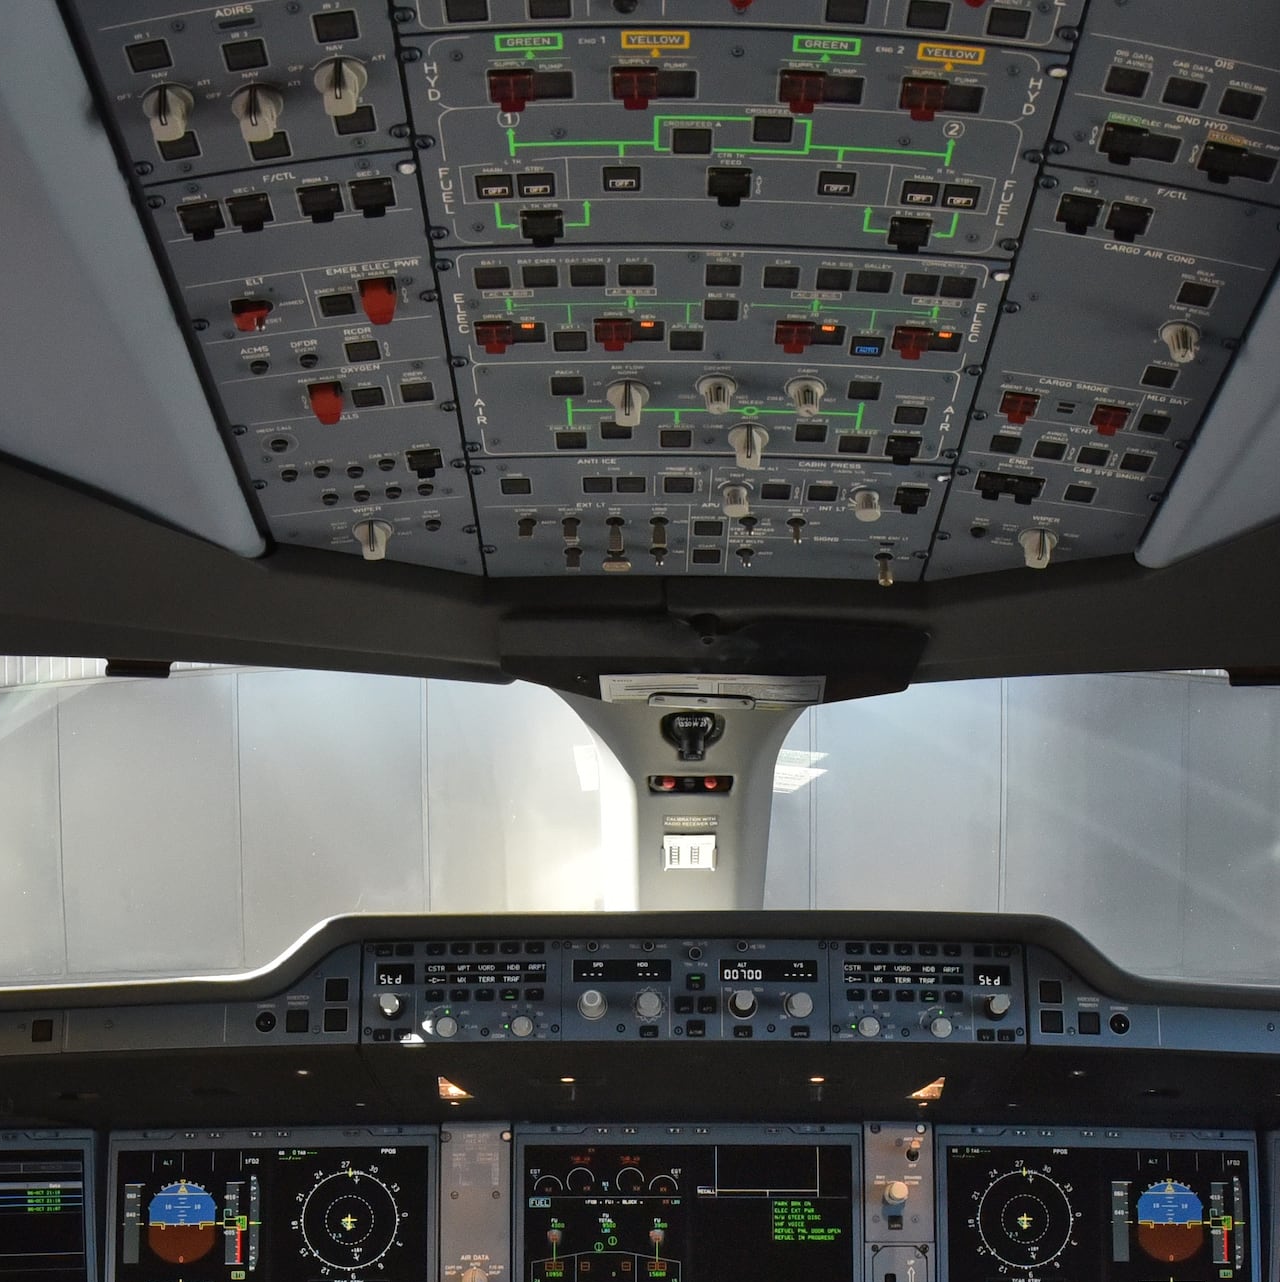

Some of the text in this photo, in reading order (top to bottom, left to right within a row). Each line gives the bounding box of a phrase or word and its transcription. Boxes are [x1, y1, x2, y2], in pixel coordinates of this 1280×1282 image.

[215, 4, 254, 19] ADIRS
[505, 36, 552, 47] GREEN
[600, 35, 607, 45] 1
[628, 34, 681, 46] YELLOW
[803, 39, 849, 51] GREEN
[325, 44, 344, 52] NAV
[896, 44, 905, 55] 2
[925, 47, 979, 60] YELLOW
[1214, 58, 1236, 71] OIS
[1175, 114, 1229, 132] GND HYD
[261, 171, 297, 184] F/CTL
[437, 167, 456, 216] FUEL
[1156, 187, 1189, 200] F/CTL
[994, 179, 1017, 227] FUEL
[1103, 242, 1196, 265] CARGO AIR COND
[325, 259, 419, 276] EMER ELEC PWR
[245, 276, 265, 288] ELT
[343, 326, 372, 337] RCDR
[289, 338, 318, 349] DFDR
[239, 344, 270, 356] ACMS
[339, 363, 381, 375] OXYGEN
[1038, 377, 1110, 394] CARGO SMOKE
[1146, 393, 1189, 408] MLG BAY
[1069, 426, 1094, 436] VENT
[798, 461, 862, 470] CABIN PRESS
[1008, 457, 1029, 467] ENG
[1073, 465, 1146, 482] CAB SYS SMOKE
[352, 505, 382, 514] WIPER
[1031, 514, 1062, 525] WIPER
[812, 535, 839, 543] SIGNS
[427, 964, 446, 973] CSTR
[457, 963, 471, 972] WPT
[506, 963, 521, 972] NDB
[528, 963, 546, 971] ARPT
[843, 964, 862, 972] CSTR
[379, 973, 402, 985] Std
[477, 975, 496, 983] TERR
[503, 975, 521, 983] TRAF
[723, 968, 763, 981] 00700
[978, 974, 1001, 986] Std
[1014, 1159, 1024, 1168] 27
[530, 1199, 551, 1207] FUEL
[460, 1253, 491, 1262] AIR DATA
